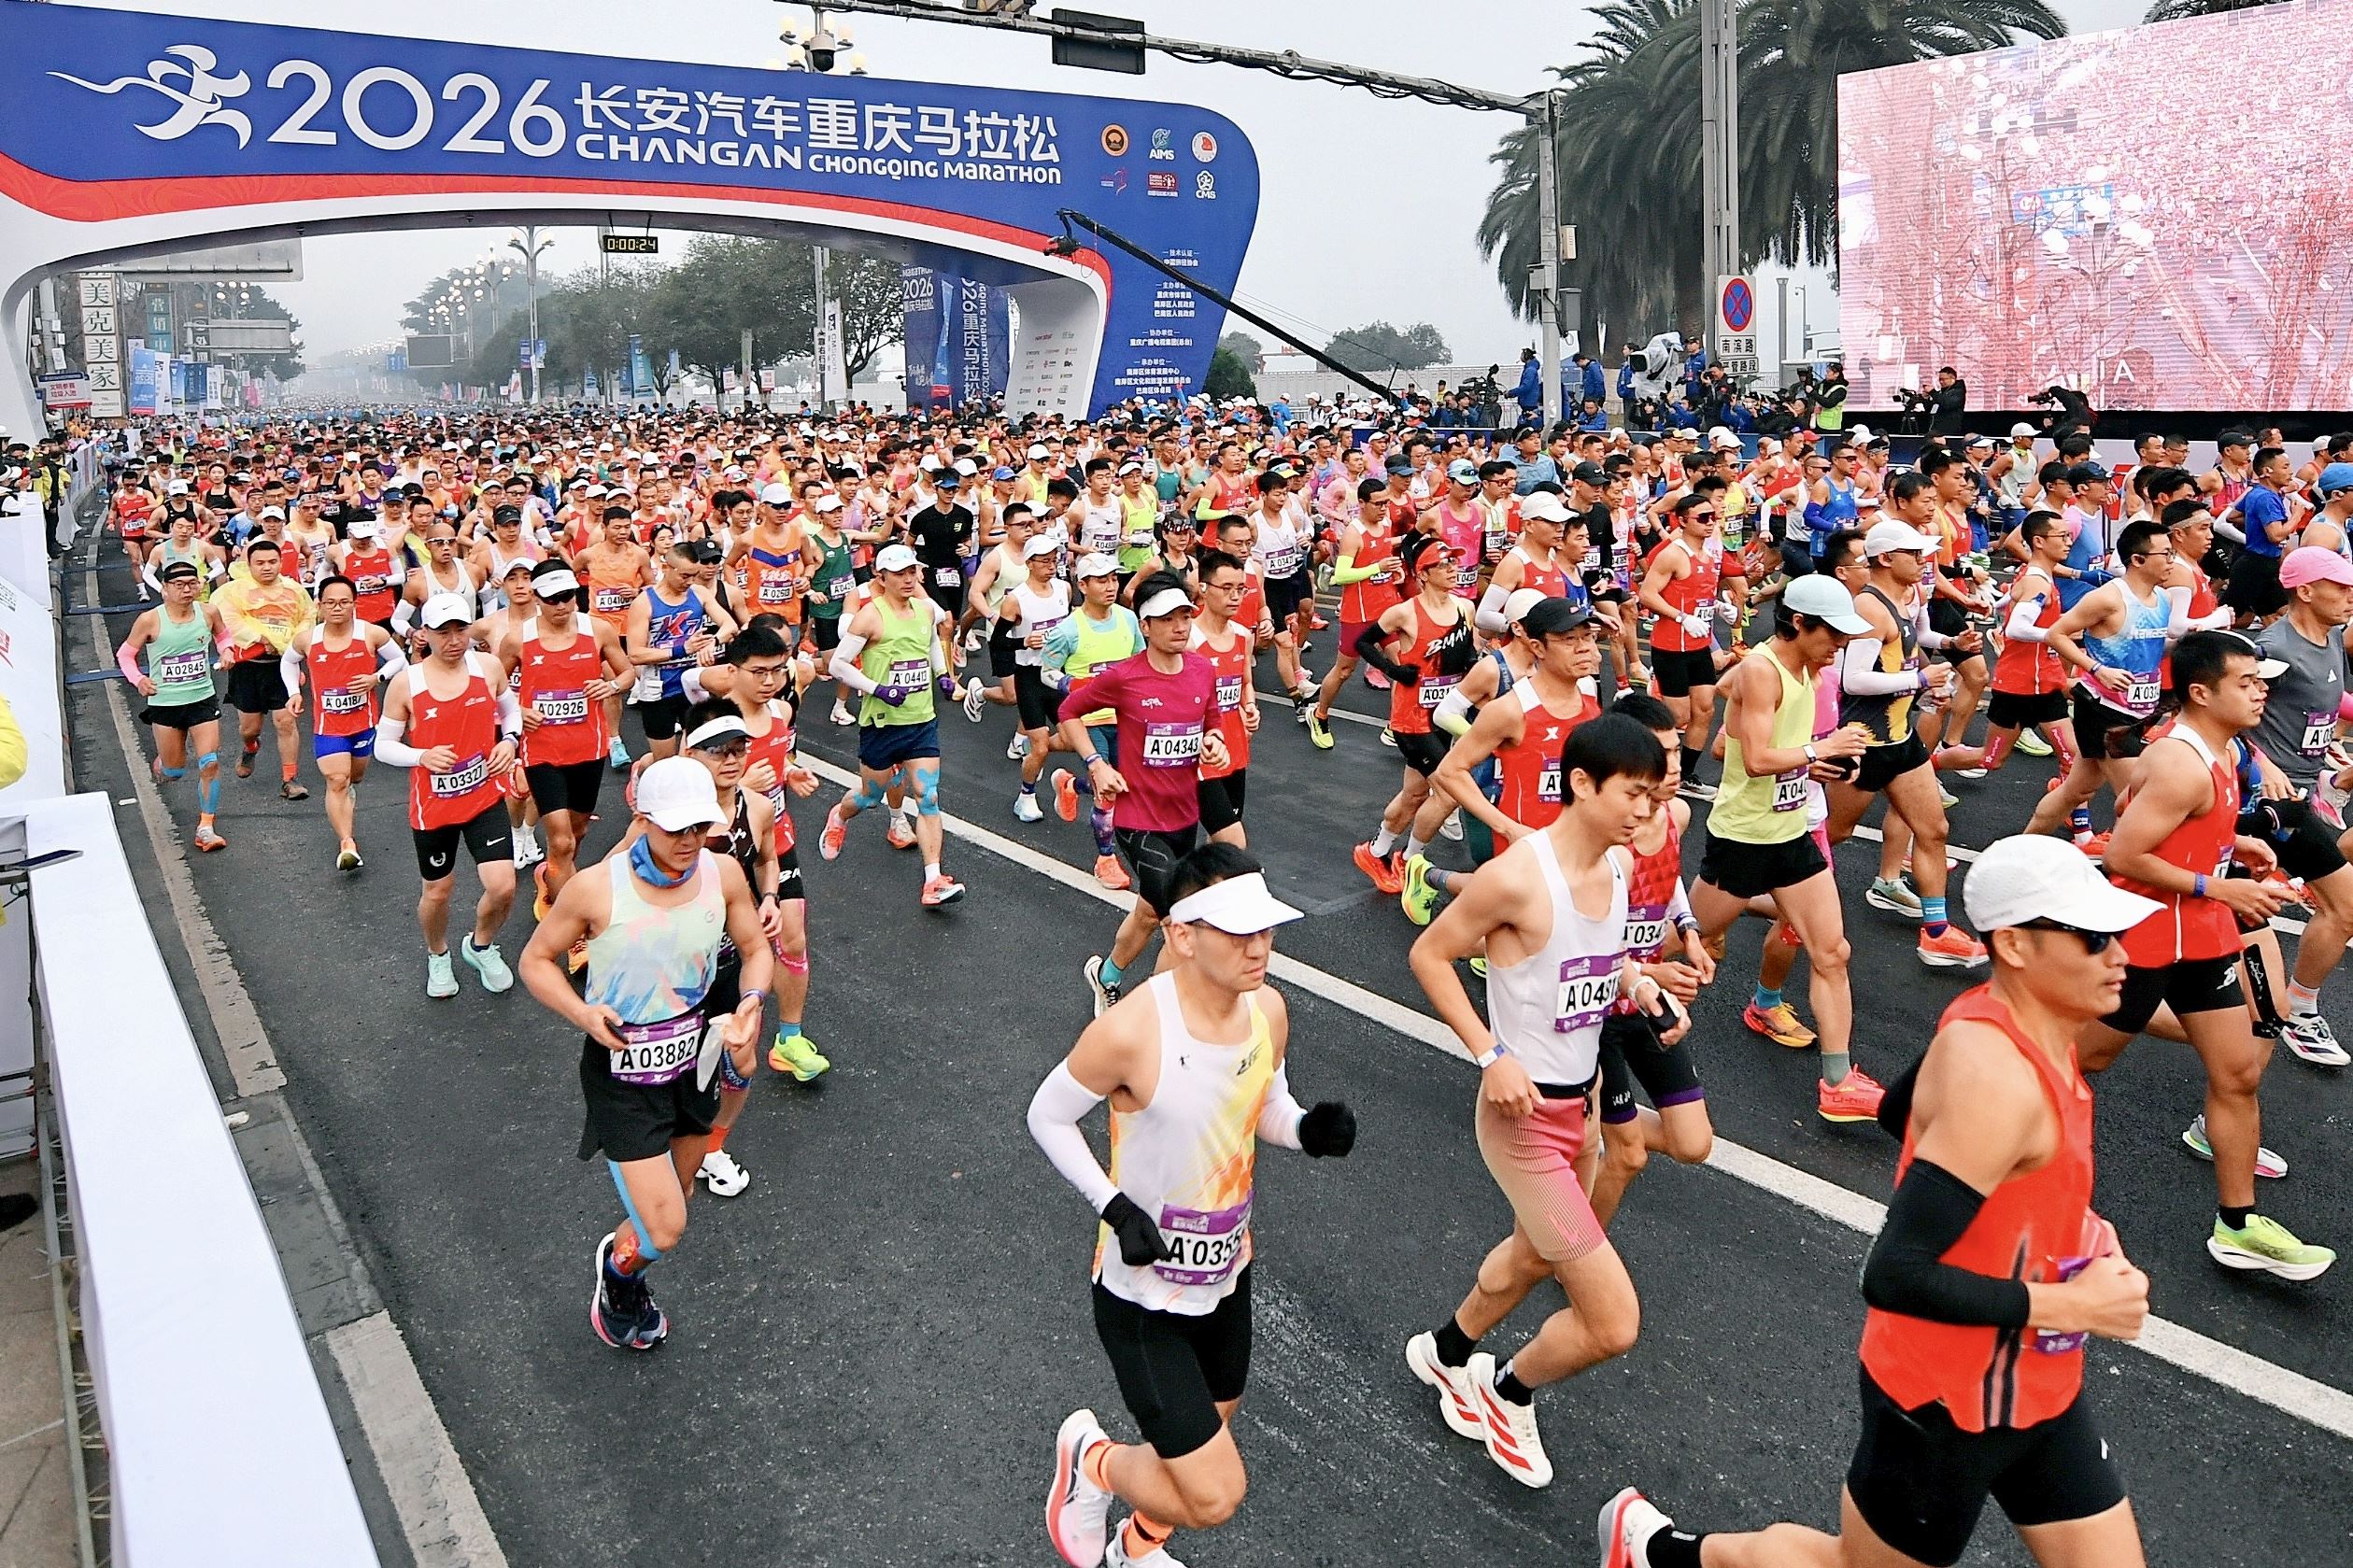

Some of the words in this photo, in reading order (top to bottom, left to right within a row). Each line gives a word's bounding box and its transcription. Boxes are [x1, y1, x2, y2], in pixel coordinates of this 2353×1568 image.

[266, 59, 567, 158] 2026
[574, 81, 1060, 163] 长安汽车重庆马拉松
[575, 133, 802, 170] CHANGAN
[1149, 148, 1175, 161] AIMS
[1196, 190, 1216, 200] CMS
[607, 238, 656, 251] 0:00:24
[902, 276, 934, 300] 2026
[83, 282, 116, 387] 美克美家
[1722, 338, 1753, 353] 南滨路
[165, 661, 204, 676] A02845
[539, 702, 585, 717] A02926
[1150, 737, 1199, 756] A04343
[619, 1036, 695, 1070] A03882
